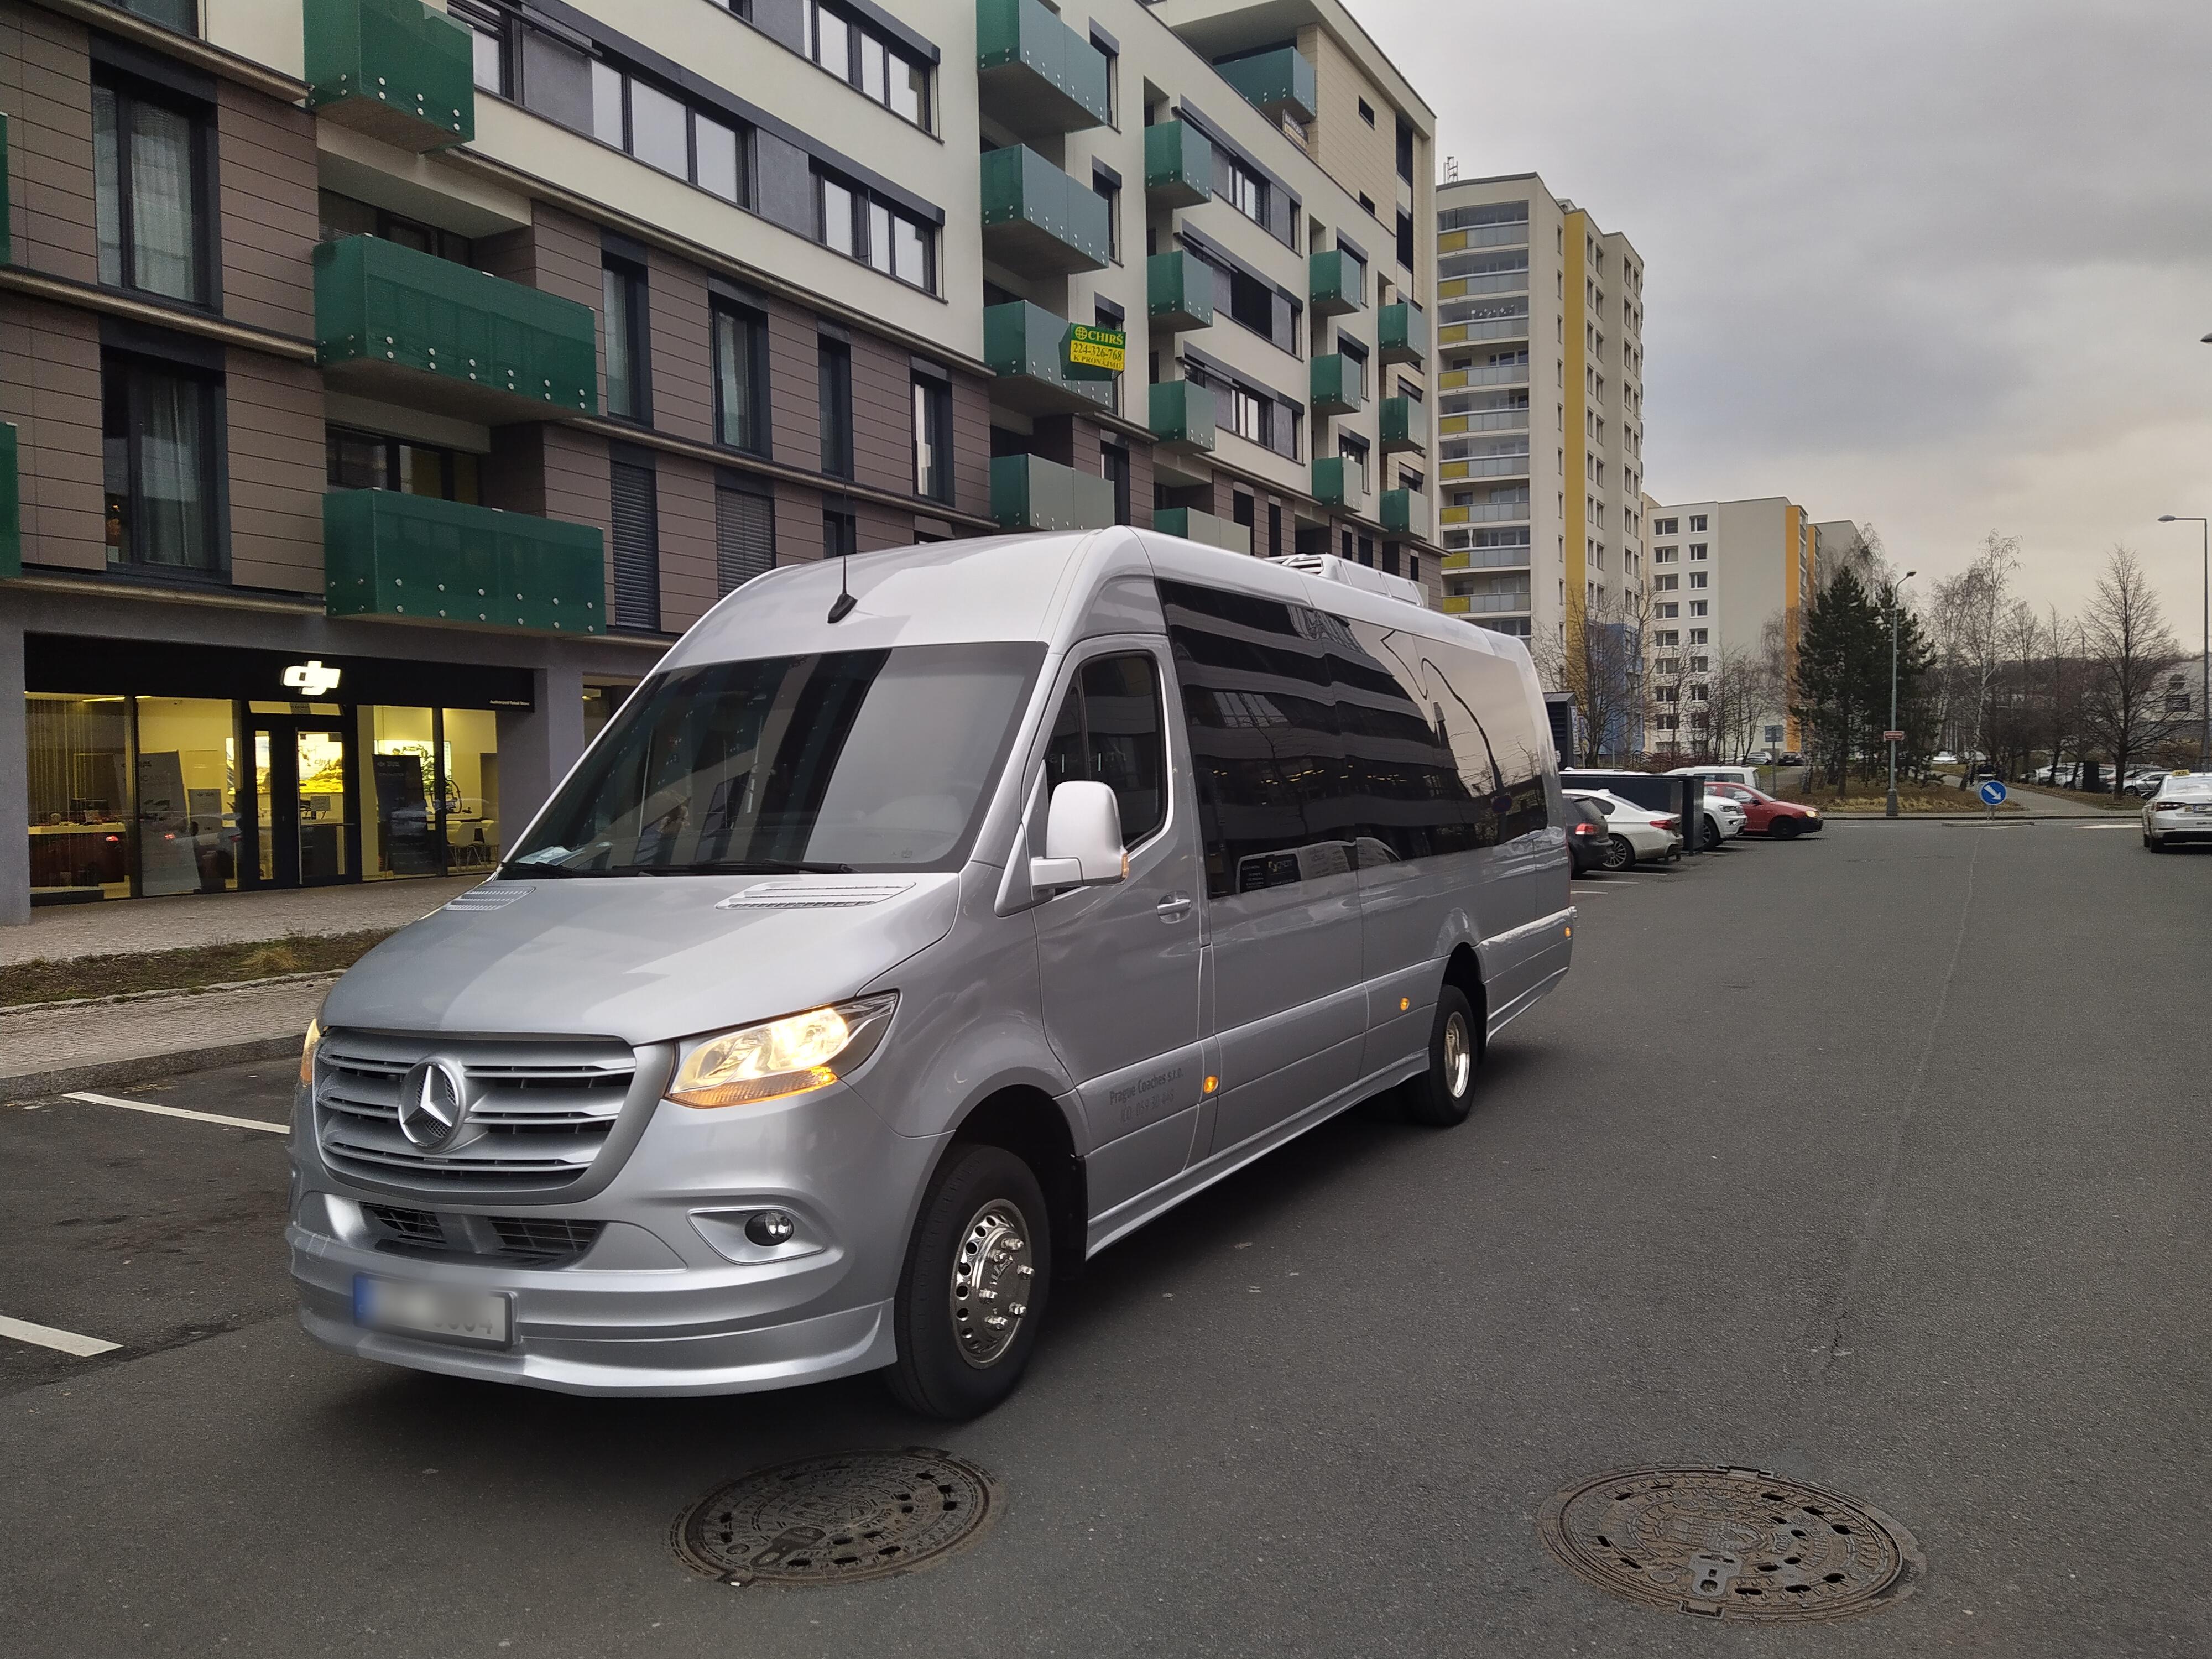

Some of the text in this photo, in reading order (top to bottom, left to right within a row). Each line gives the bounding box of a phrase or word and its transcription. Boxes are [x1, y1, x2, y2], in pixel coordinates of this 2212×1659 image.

[1073, 342, 1123, 361] 224-326-768
[1109, 1086, 1136, 1105] Prague
[1138, 1074, 1166, 1094] Coaches
